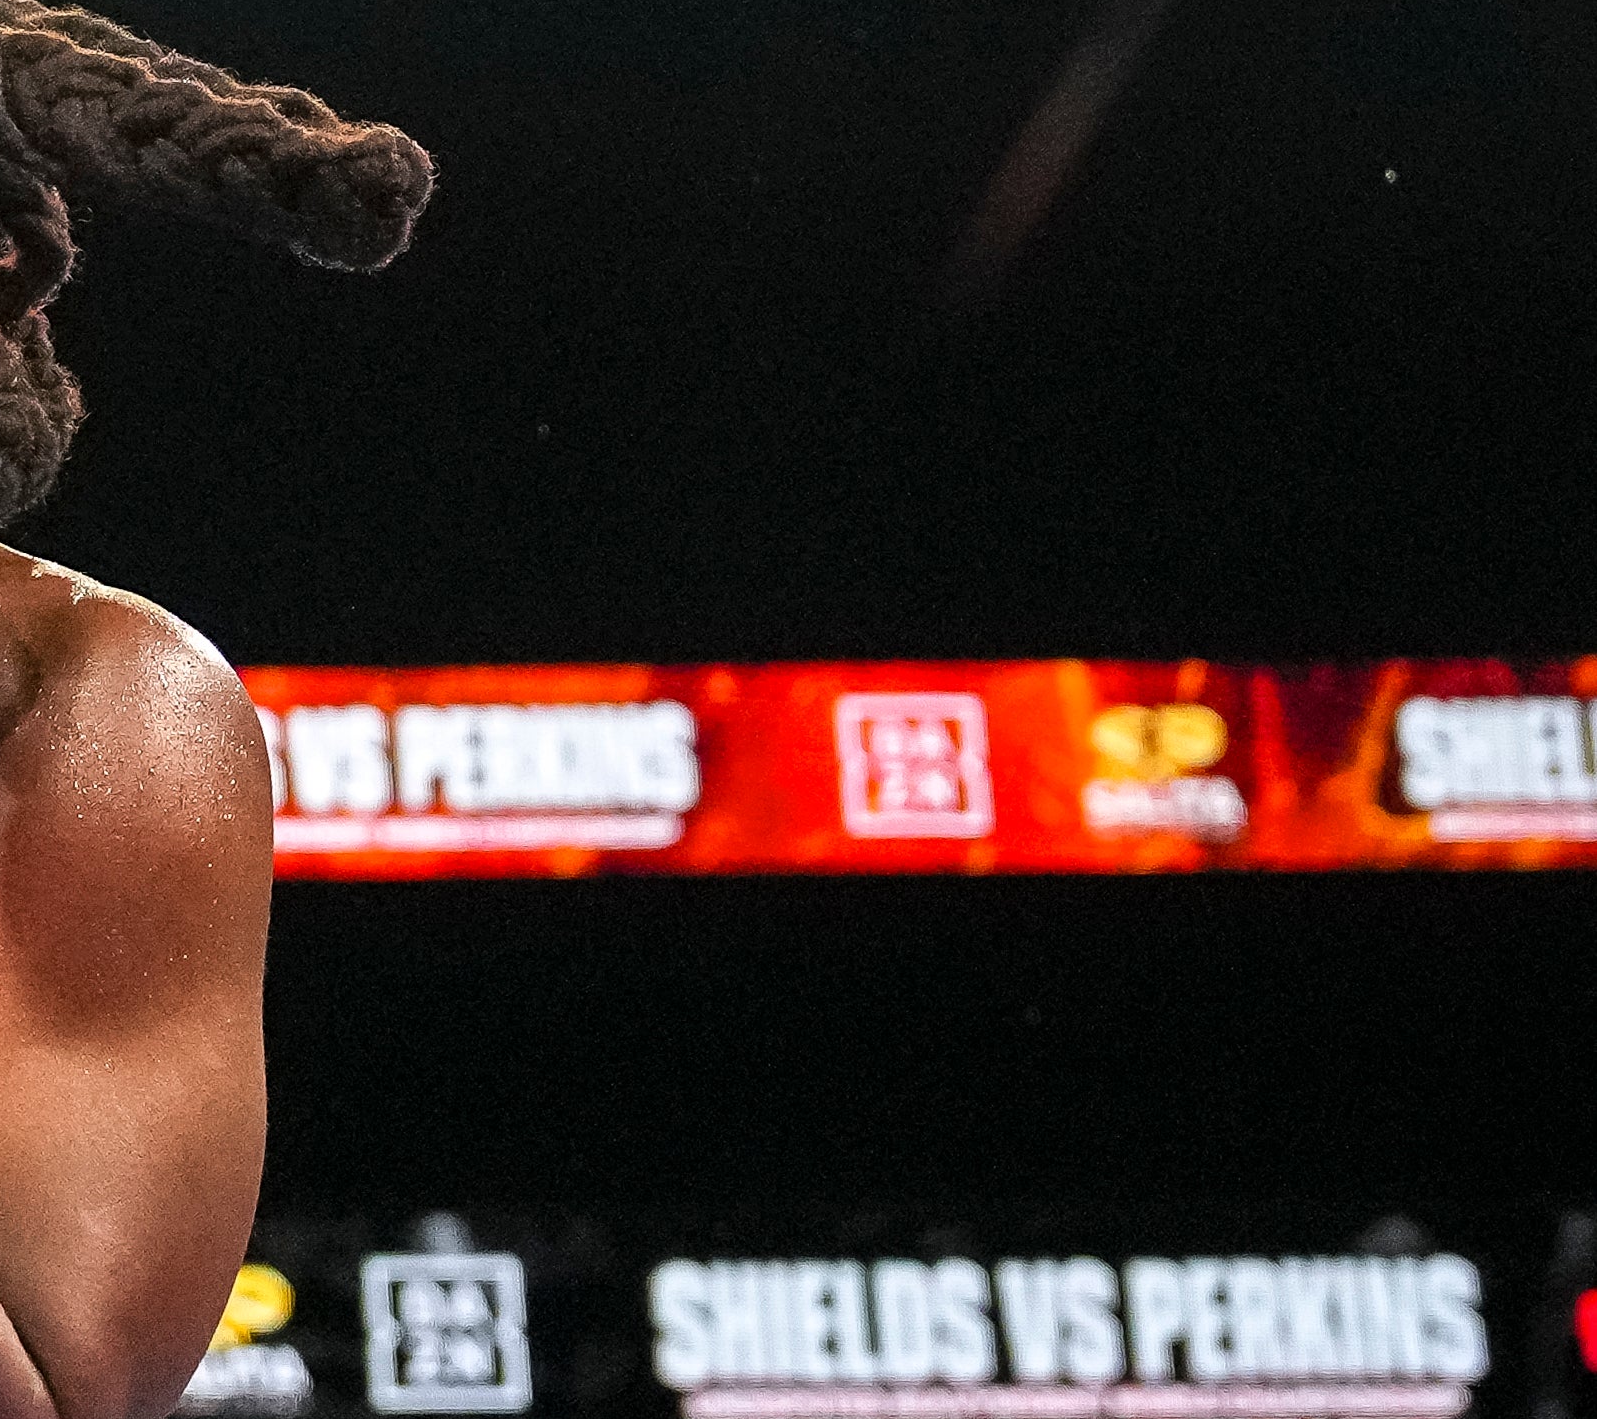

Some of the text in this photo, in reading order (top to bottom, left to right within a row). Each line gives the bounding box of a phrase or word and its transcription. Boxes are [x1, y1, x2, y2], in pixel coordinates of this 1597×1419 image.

[392, 698, 701, 813] PERKINS
[647, 1255, 997, 1389] SHIELDS
[995, 1255, 1124, 1384] VS
[1122, 1252, 1490, 1384] PERKINS
